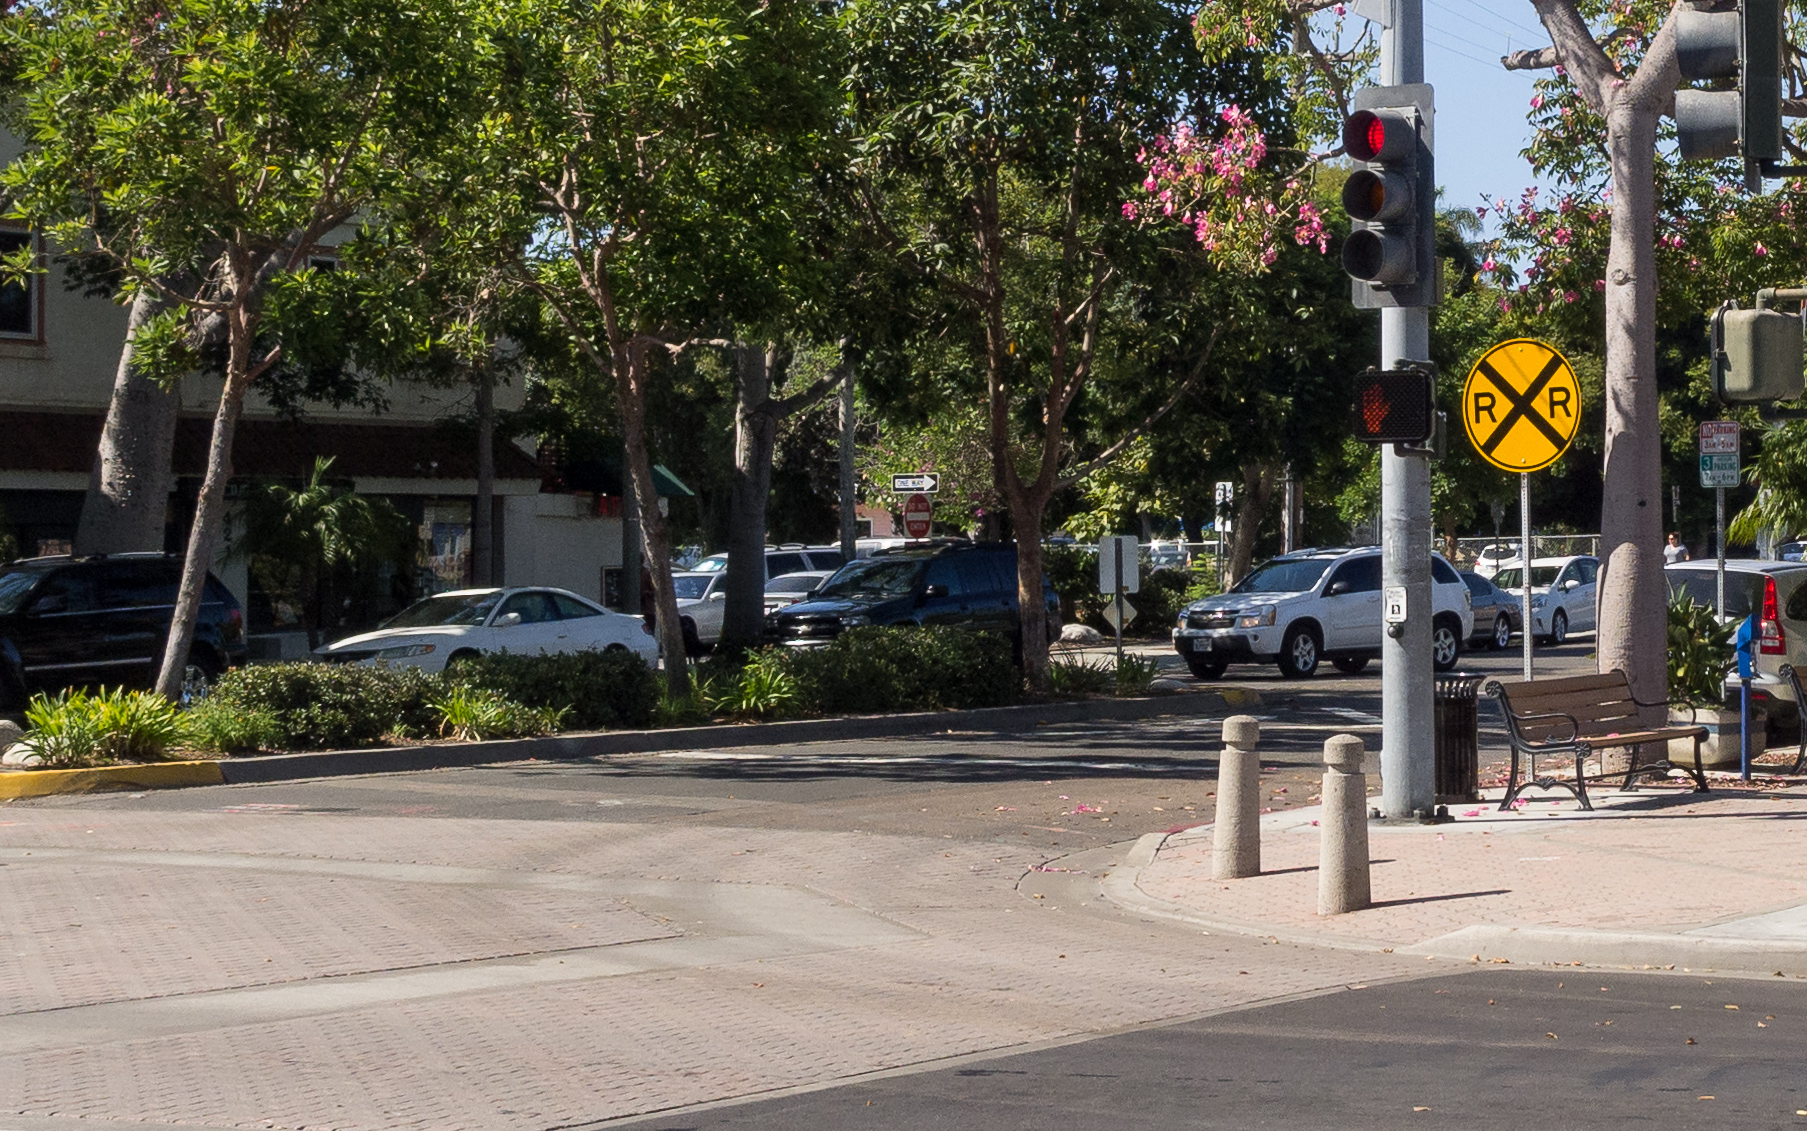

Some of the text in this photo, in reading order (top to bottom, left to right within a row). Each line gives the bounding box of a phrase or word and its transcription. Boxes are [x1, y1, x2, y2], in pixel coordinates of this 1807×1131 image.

[1474, 386, 1572, 424] R R
[1703, 457, 1711, 470] 3
[1714, 463, 1736, 471] PARKING
